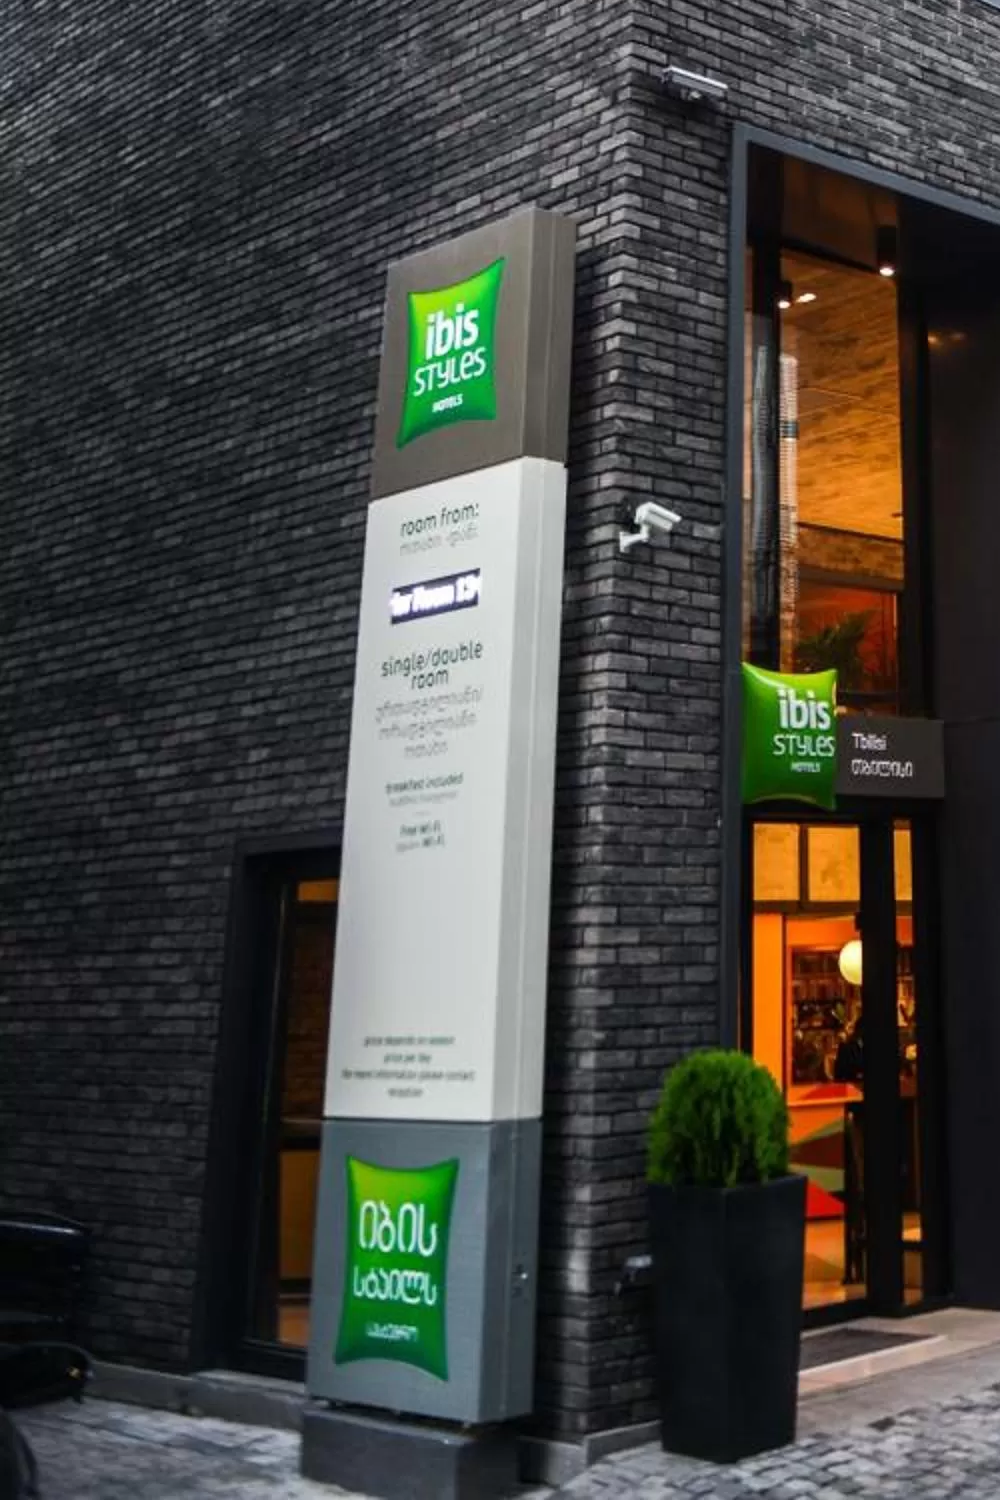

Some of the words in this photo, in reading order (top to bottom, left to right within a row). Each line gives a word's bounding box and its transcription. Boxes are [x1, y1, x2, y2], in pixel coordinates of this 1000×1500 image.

[425, 302, 479, 360] ibis
[400, 515, 437, 538] room
[440, 502, 480, 527] from:
[381, 640, 483, 678] single/double
[411, 669, 449, 690] room
[777, 687, 831, 730] ibis
[359, 1199, 438, 1257] იბის
